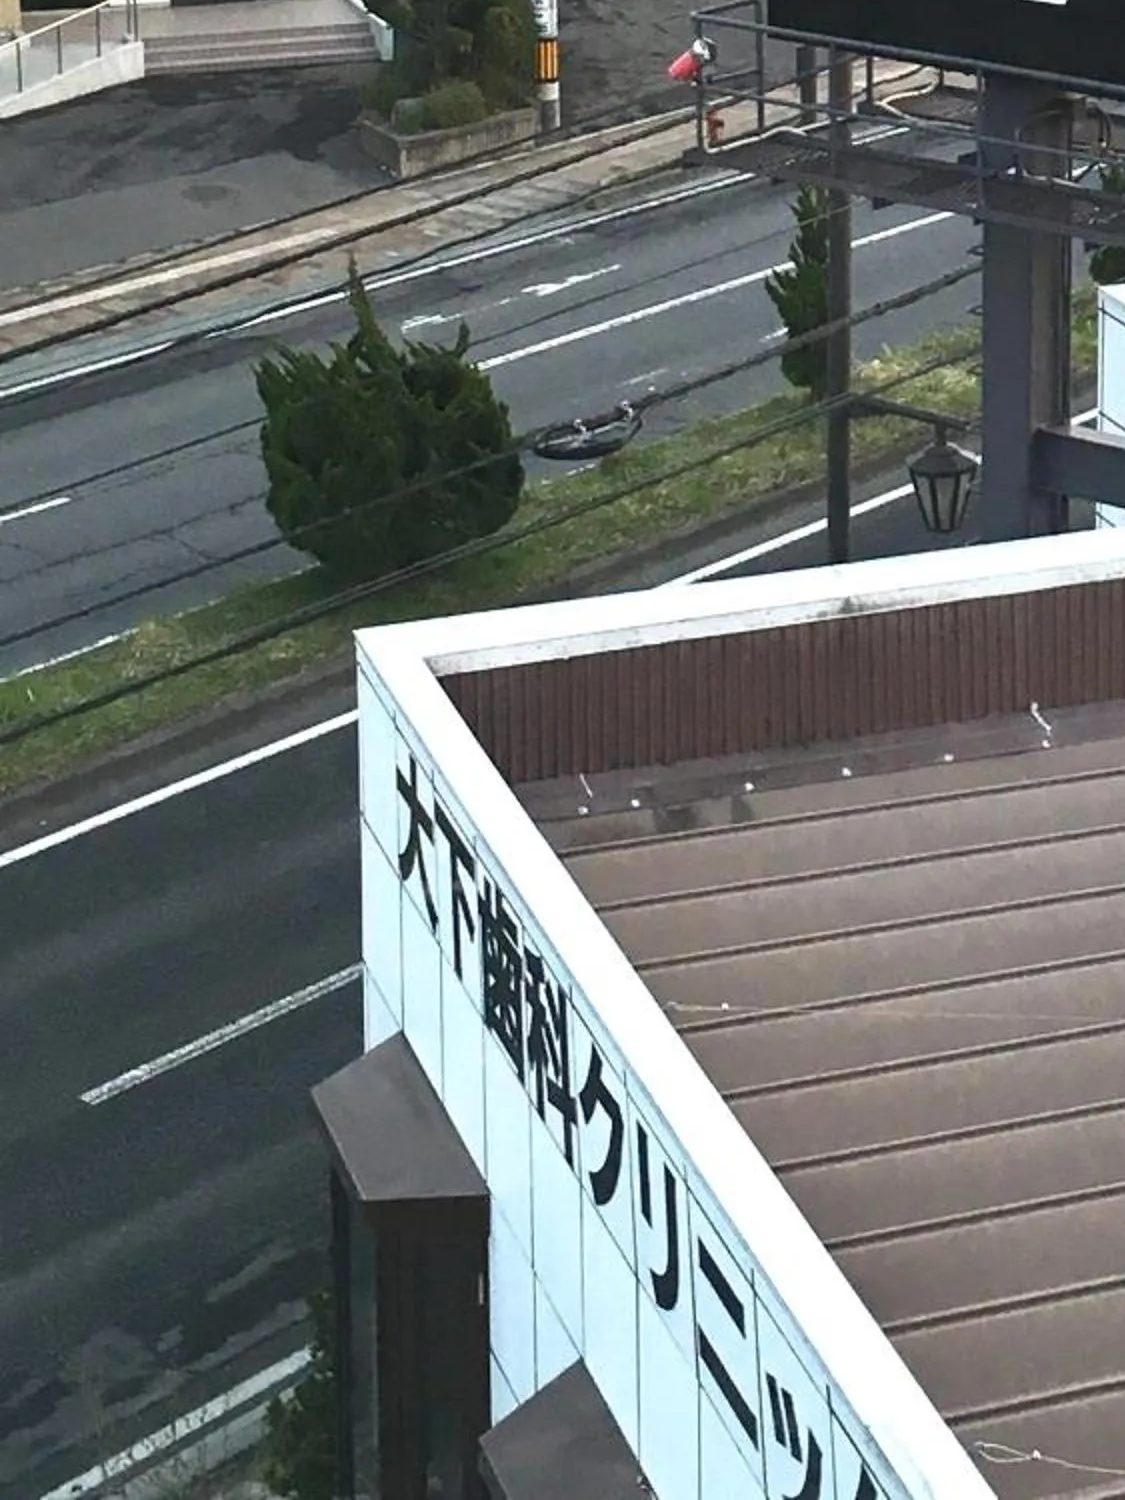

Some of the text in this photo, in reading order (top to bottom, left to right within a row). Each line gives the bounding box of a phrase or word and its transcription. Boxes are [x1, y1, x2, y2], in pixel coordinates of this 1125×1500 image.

[395, 751, 878, 1500] 大下歯科クリニッ
